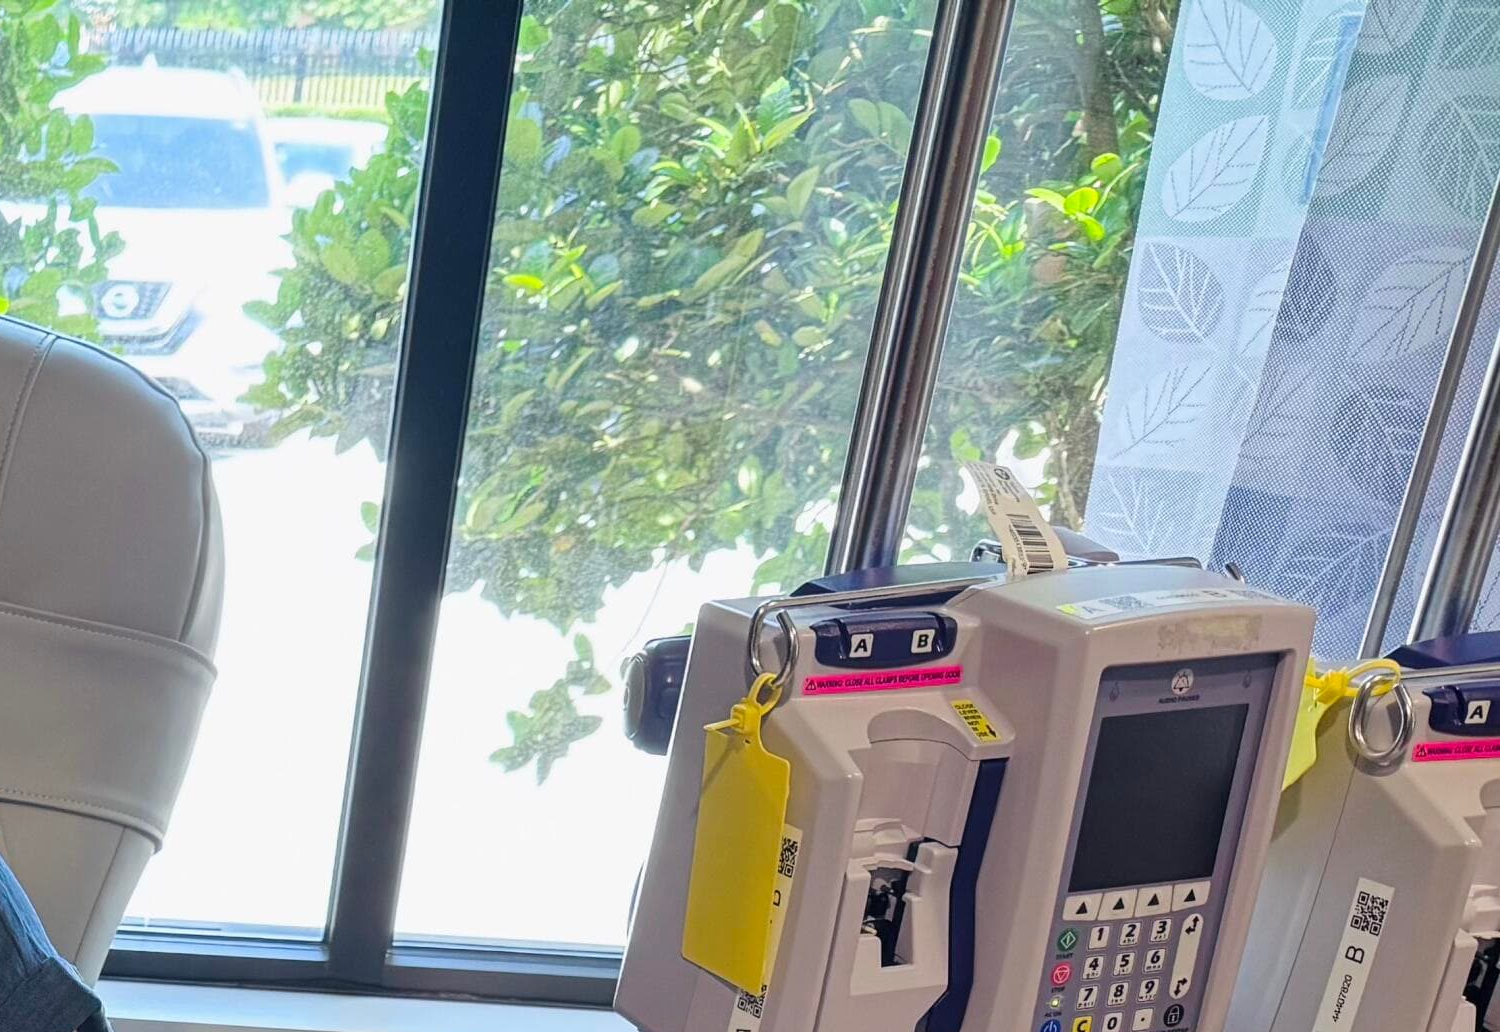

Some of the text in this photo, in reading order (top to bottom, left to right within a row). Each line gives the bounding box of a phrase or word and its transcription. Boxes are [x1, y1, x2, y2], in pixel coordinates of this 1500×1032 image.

[853, 638, 868, 653] A
[916, 634, 929, 649] B
[864, 678, 875, 686] ALL
[1468, 704, 1483, 720] A
[1097, 920, 1167, 941] 1 2 3
[1088, 957, 1099, 971] 4
[1119, 954, 1130, 968] 5
[1150, 950, 1161, 964] 6
[1344, 945, 1365, 965] B
[1083, 987, 1094, 1002] 7
[1113, 984, 1125, 998] 8
[1144, 980, 1155, 994] 9
[1331, 974, 1353, 1023] 44407820
[1107, 1017, 1118, 1031] 0
